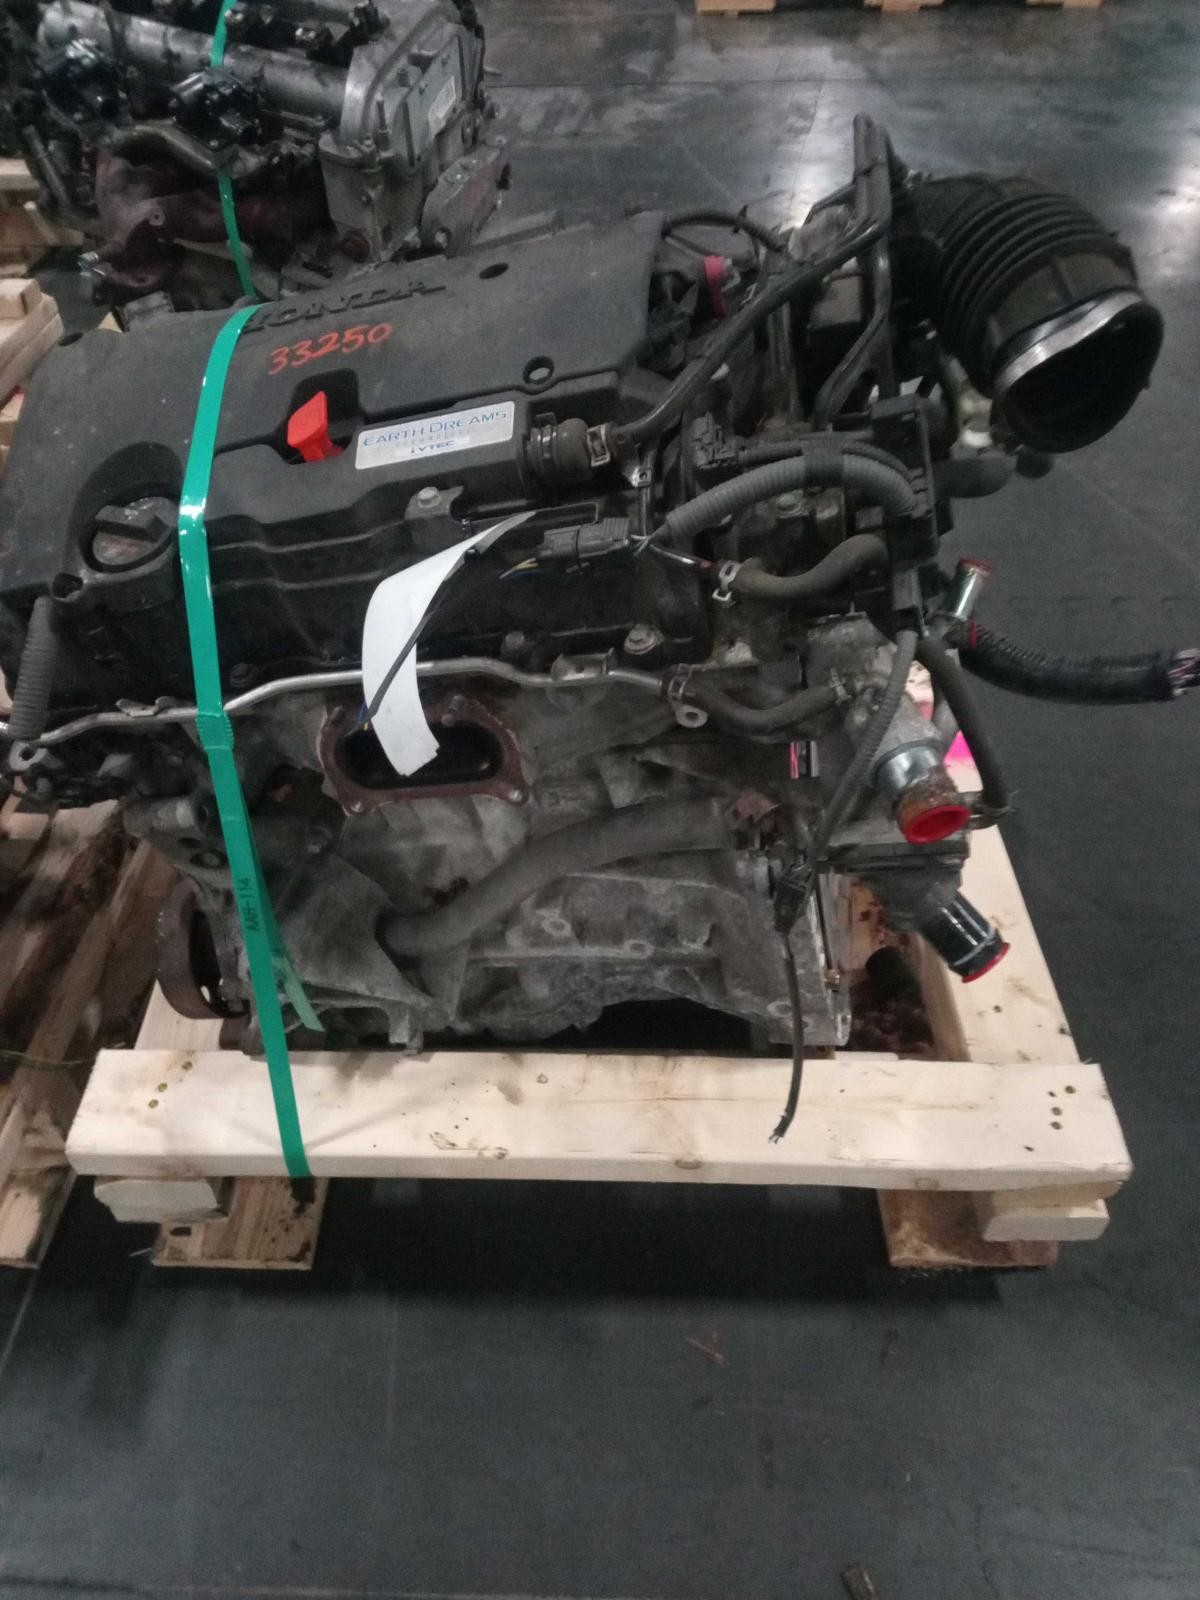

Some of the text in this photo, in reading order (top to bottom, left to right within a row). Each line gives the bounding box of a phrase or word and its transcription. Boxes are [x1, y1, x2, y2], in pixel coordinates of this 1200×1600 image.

[268, 322, 394, 375] 33250
[363, 427, 424, 447] EARTH
[429, 410, 506, 433] DREAMS
